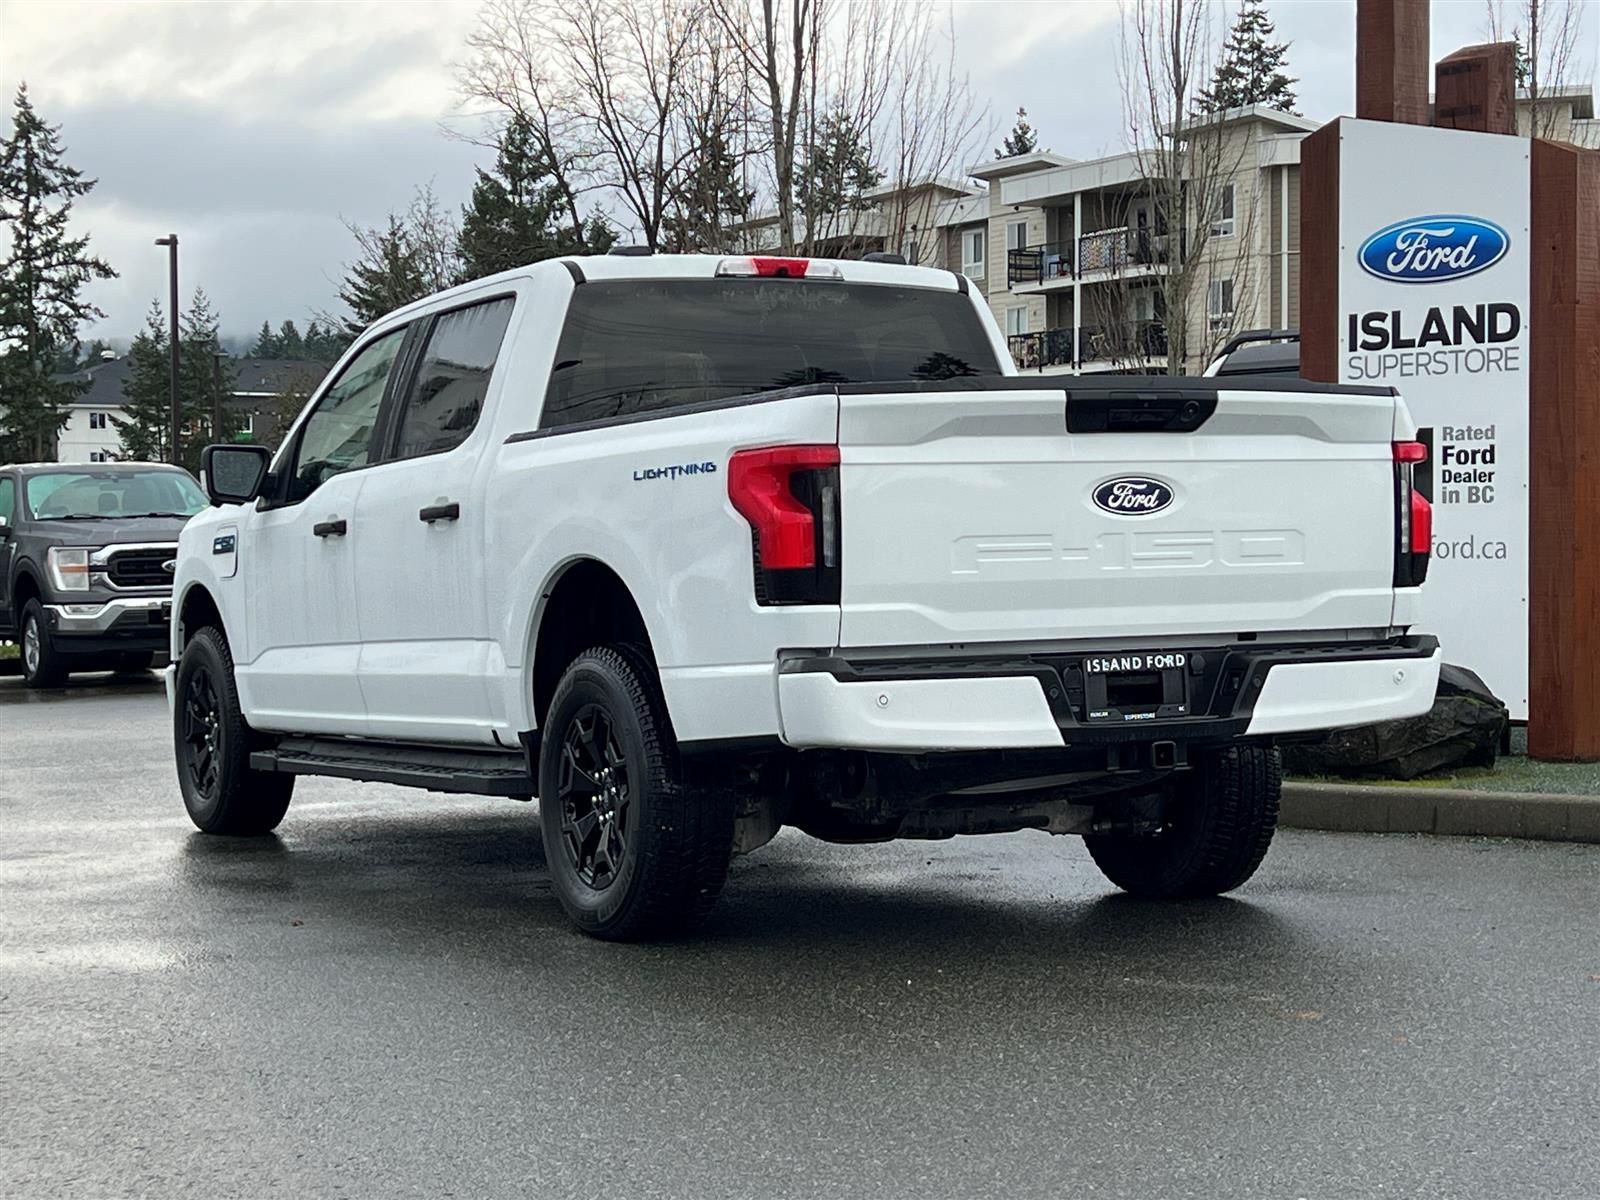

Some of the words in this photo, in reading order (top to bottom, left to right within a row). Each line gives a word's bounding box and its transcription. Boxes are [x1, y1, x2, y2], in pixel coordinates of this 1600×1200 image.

[1386, 226, 1479, 273] Ford
[1348, 302, 1521, 352] ISLAND
[1347, 346, 1520, 380] SUPERSTORE
[1442, 424, 1496, 441] Rated
[1442, 444, 1496, 465] Ford
[633, 462, 717, 481] LIGHTNING
[1442, 469, 1496, 483] Dealer
[1107, 483, 1159, 508] Ford
[1442, 486, 1460, 504] in
[1467, 485, 1495, 503] BC
[951, 528, 1305, 575] F-150
[1087, 657, 1142, 672] ISLAND
[1146, 653, 1186, 669] FORD
